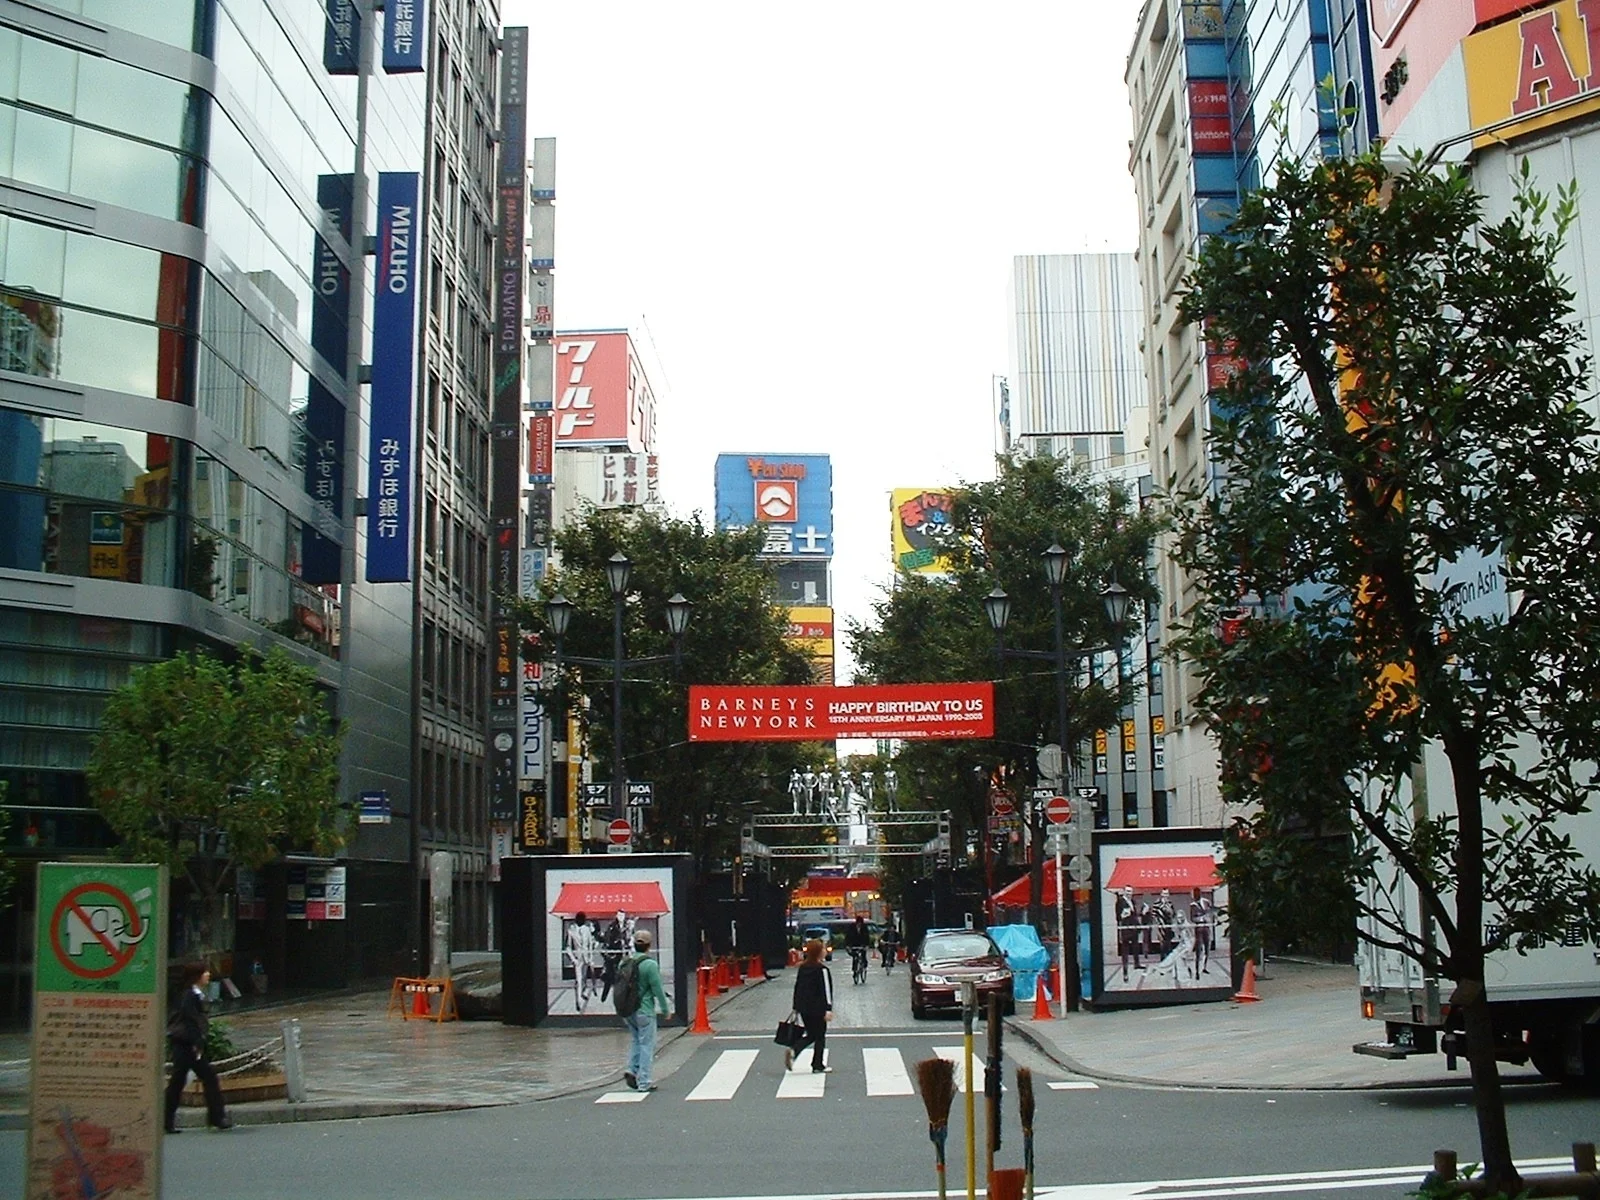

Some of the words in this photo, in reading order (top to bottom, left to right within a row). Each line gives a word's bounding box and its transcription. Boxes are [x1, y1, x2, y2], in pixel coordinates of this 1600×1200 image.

[389, 205, 411, 294] MIZUHO
[557, 340, 597, 437] ワールド
[378, 438, 399, 538] みずほ銀行
[602, 455, 618, 503] ビル
[1477, 563, 1498, 598] Ash
[700, 698, 814, 711] BARNEYS
[829, 702, 874, 714] HAPPY
[876, 701, 940, 713] BIRTHDAY
[943, 700, 962, 712] TO
[965, 699, 983, 711] US
[829, 716, 848, 724] 15TH
[849, 715, 904, 723] ANNIVERSARY
[906, 714, 915, 723] IN
[916, 714, 943, 722] JAPAN
[587, 785, 606, 795] モア
[629, 785, 651, 795] MOA
